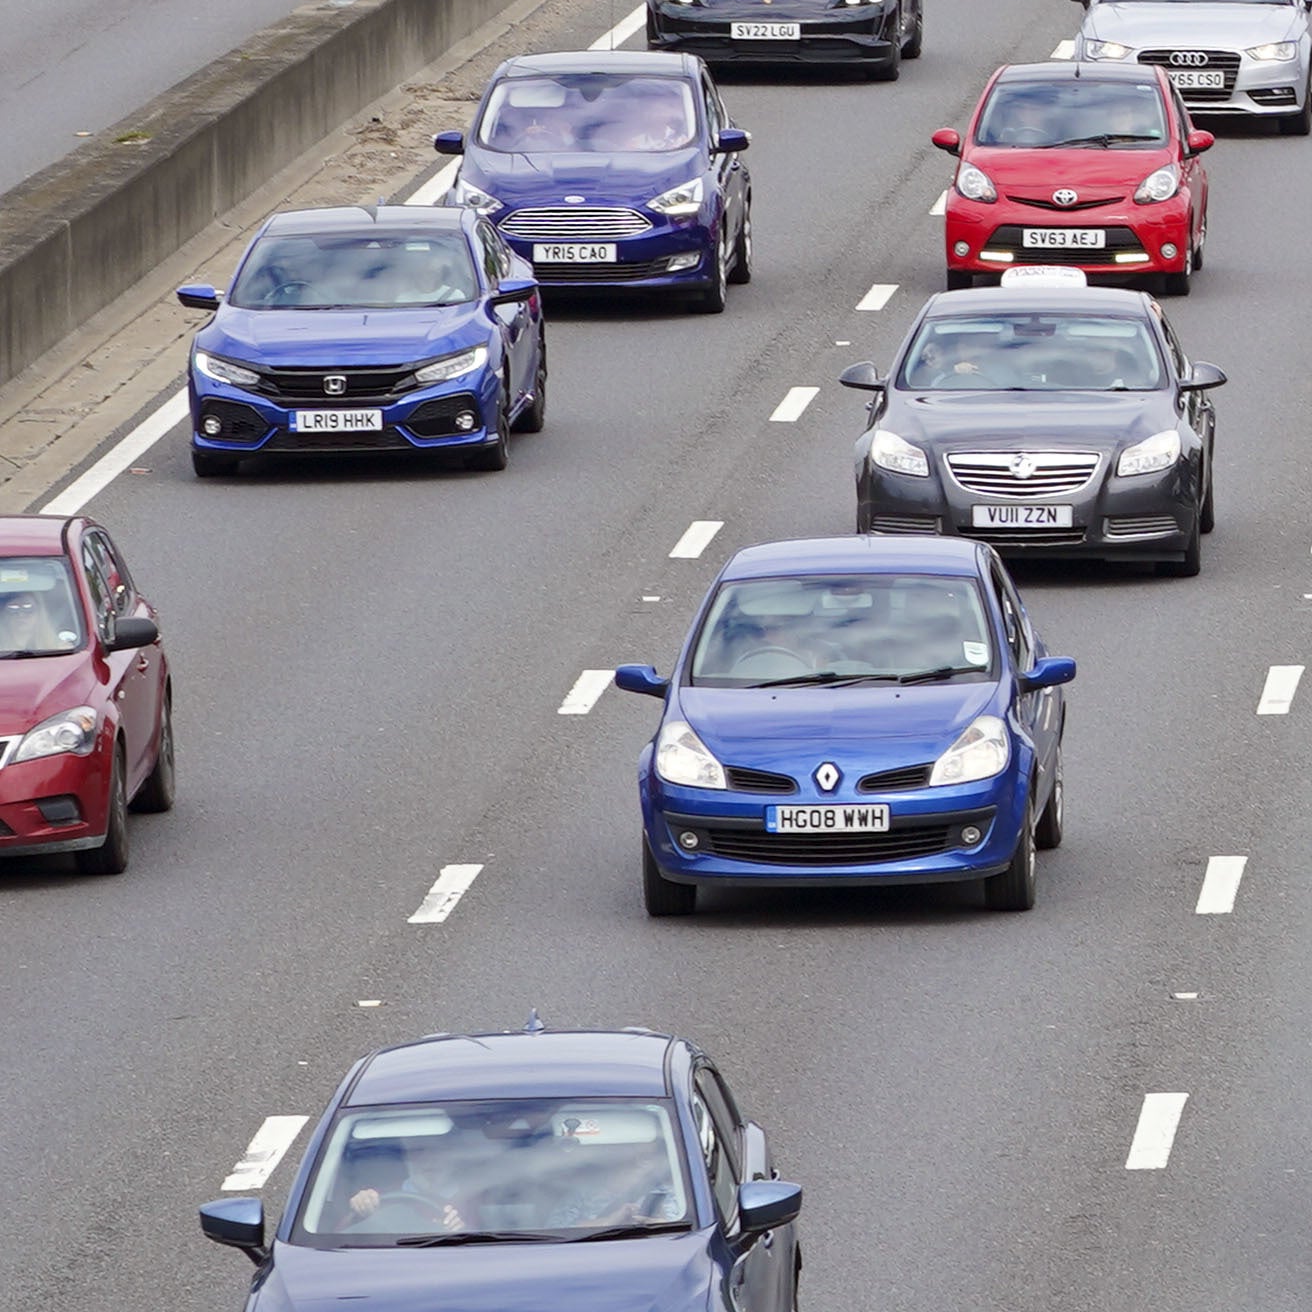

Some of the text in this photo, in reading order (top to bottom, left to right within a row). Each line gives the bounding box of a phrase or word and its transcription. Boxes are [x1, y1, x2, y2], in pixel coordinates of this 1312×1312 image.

[737, 25, 794, 37] SV22 LGU
[1198, 74, 1221, 86] CSO
[1030, 232, 1097, 245] SV63 AEJ
[544, 247, 606, 259] YR15 CAO
[304, 414, 374, 428] LR19 HHK
[988, 506, 1056, 523] VU11 ZZN
[782, 809, 883, 828] HG08 WWH
